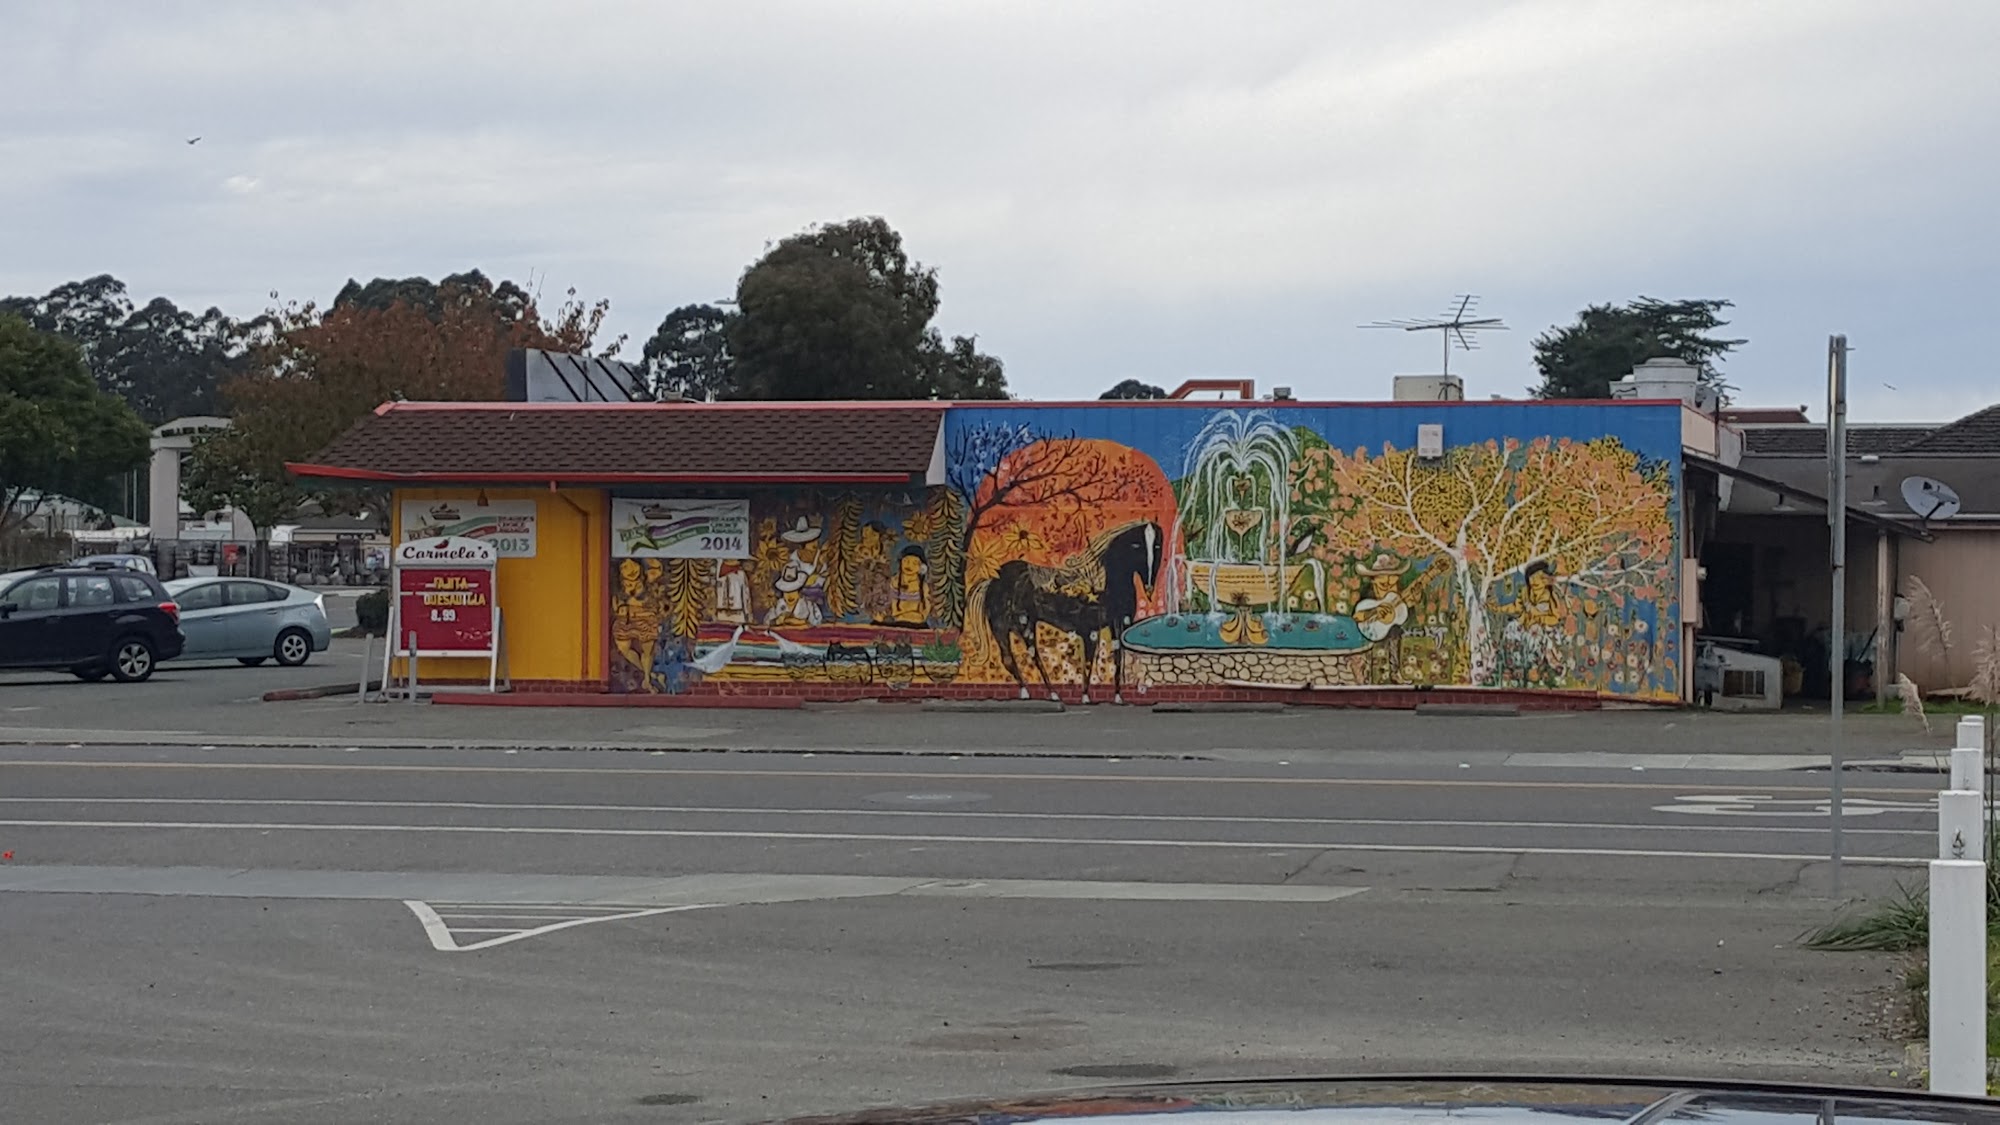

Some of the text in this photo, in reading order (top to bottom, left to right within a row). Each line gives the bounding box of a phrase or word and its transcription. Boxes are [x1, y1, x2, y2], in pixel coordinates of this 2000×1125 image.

[488, 538, 530, 552] 2013
[700, 536, 742, 550] 2014
[402, 546, 489, 559] Carmela's
[433, 577, 469, 589] FAJITA
